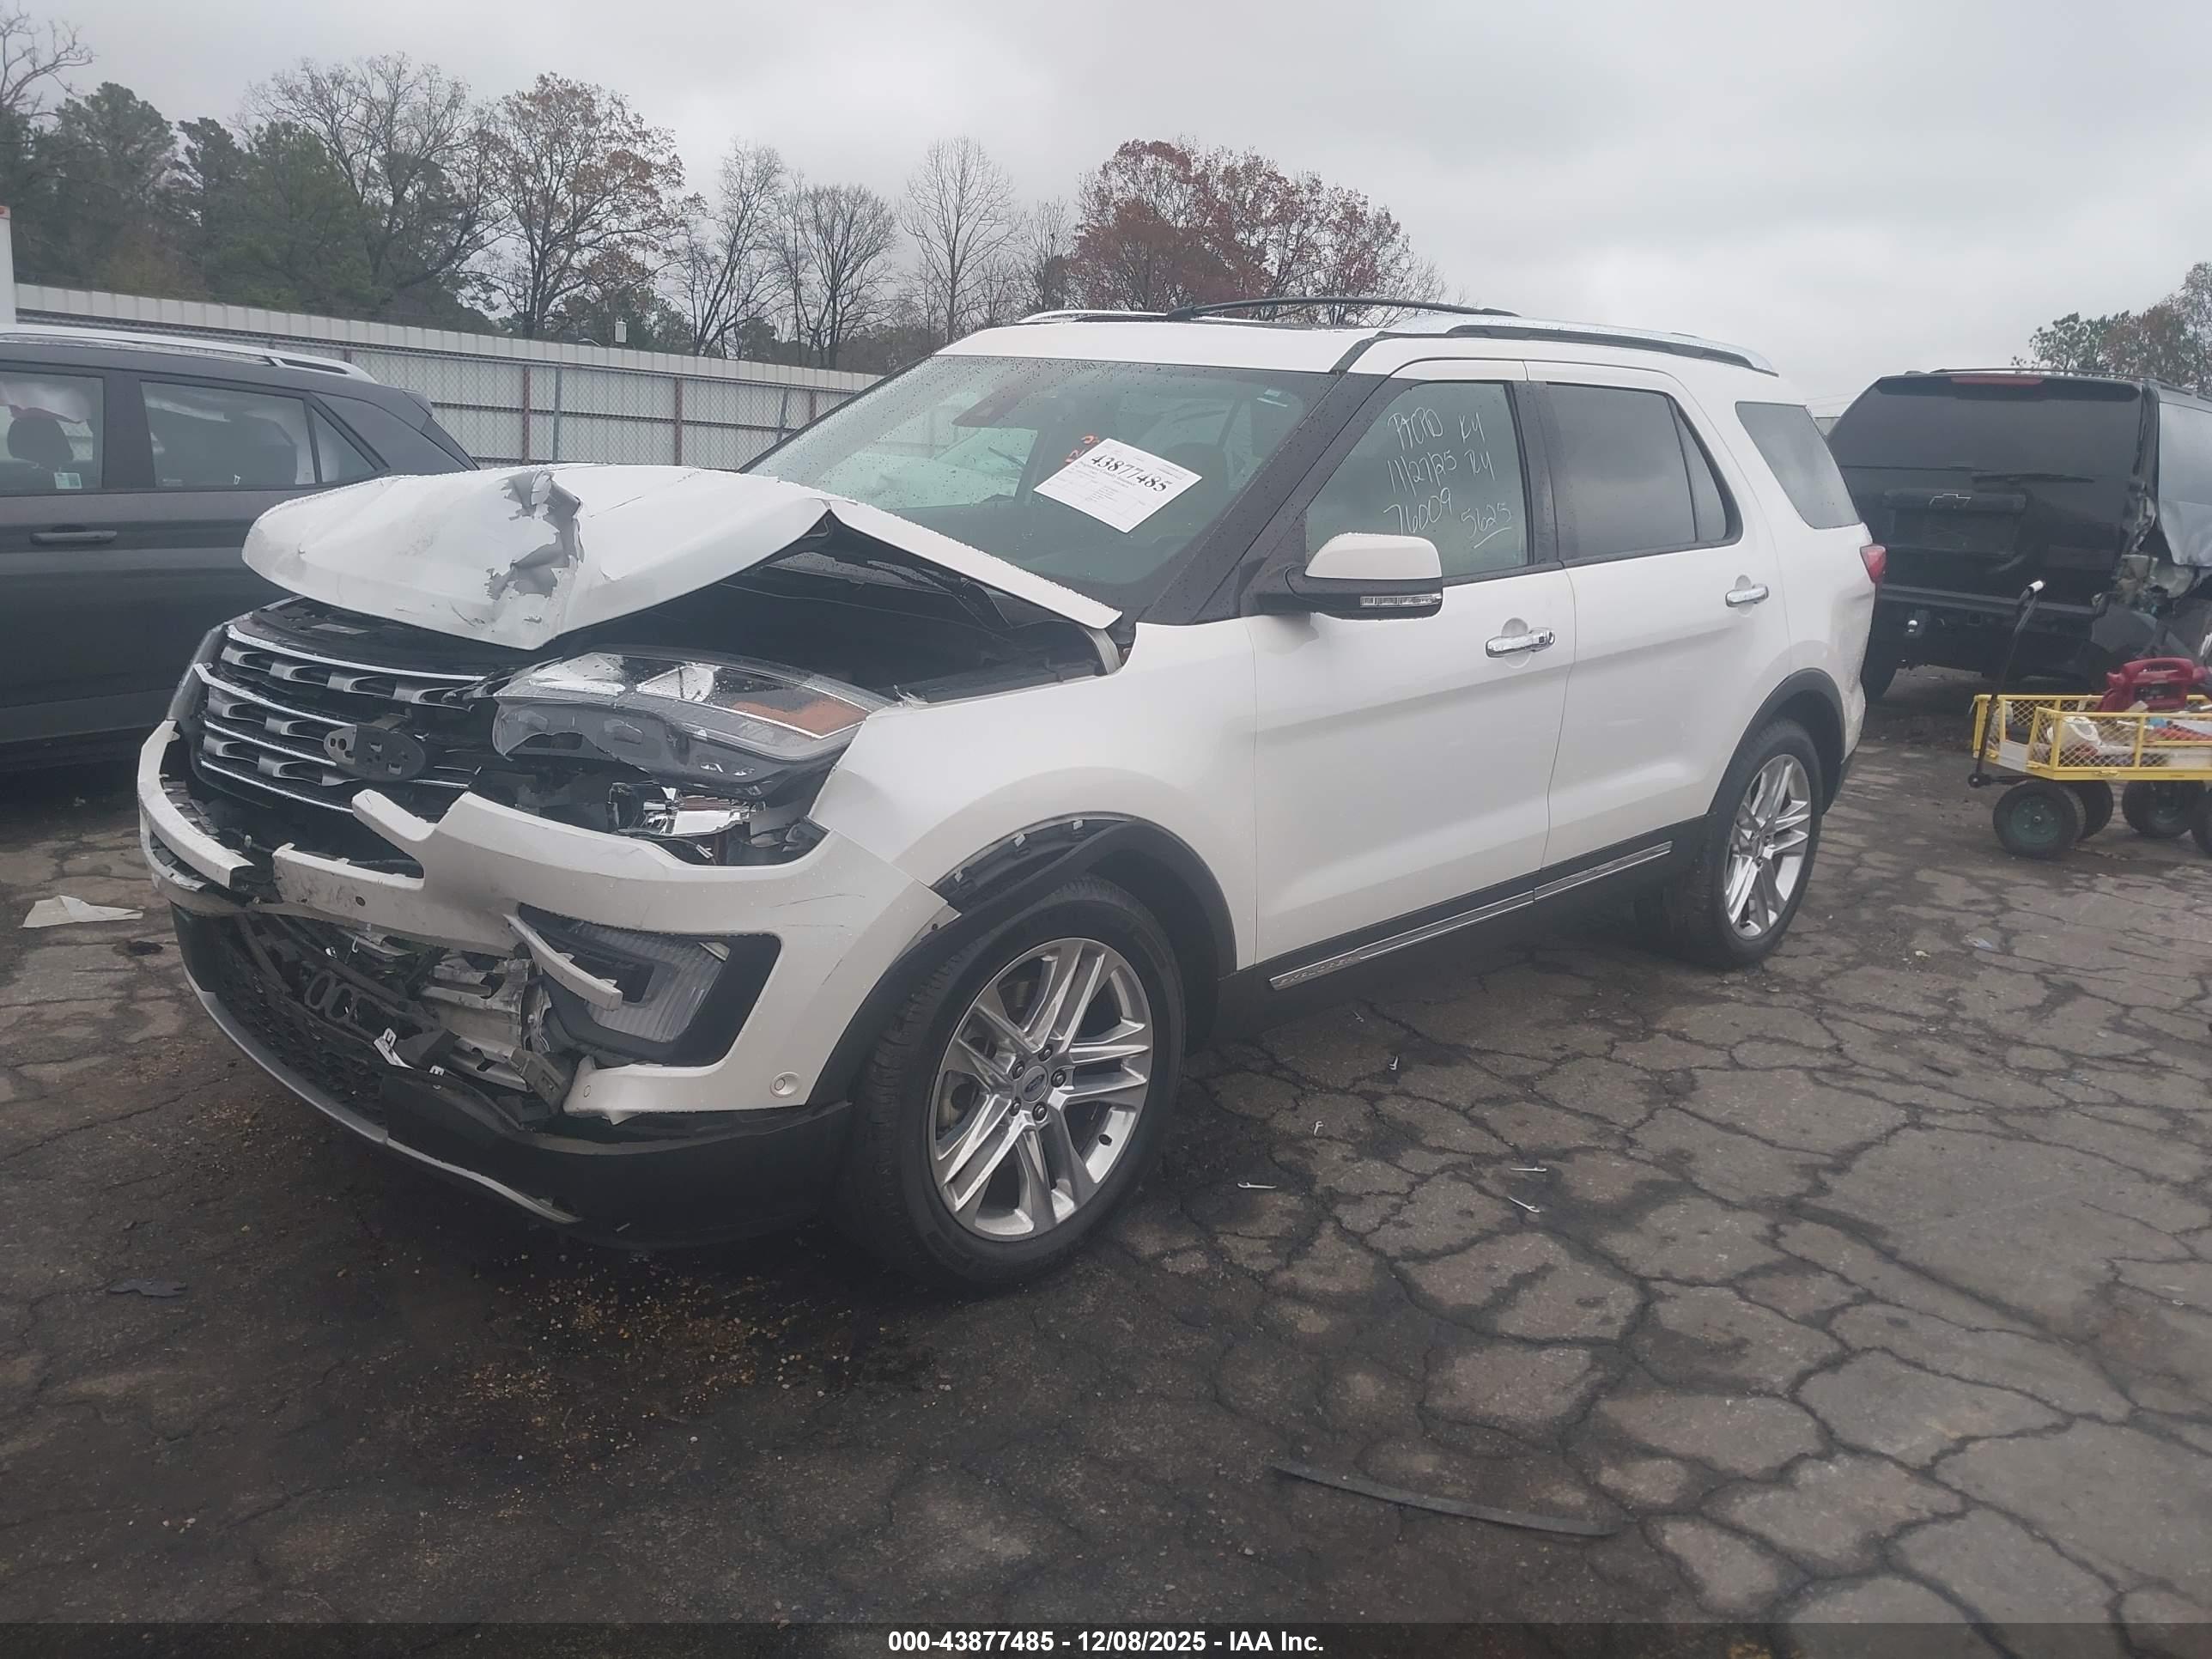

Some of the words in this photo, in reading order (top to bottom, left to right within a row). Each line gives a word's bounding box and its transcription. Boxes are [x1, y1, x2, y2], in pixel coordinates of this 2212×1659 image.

[1091, 454, 1173, 492] 43877485
[1387, 449, 1457, 497] 11/27/25
[1383, 487, 1453, 536] 76009
[1461, 502, 1511, 539] 5625
